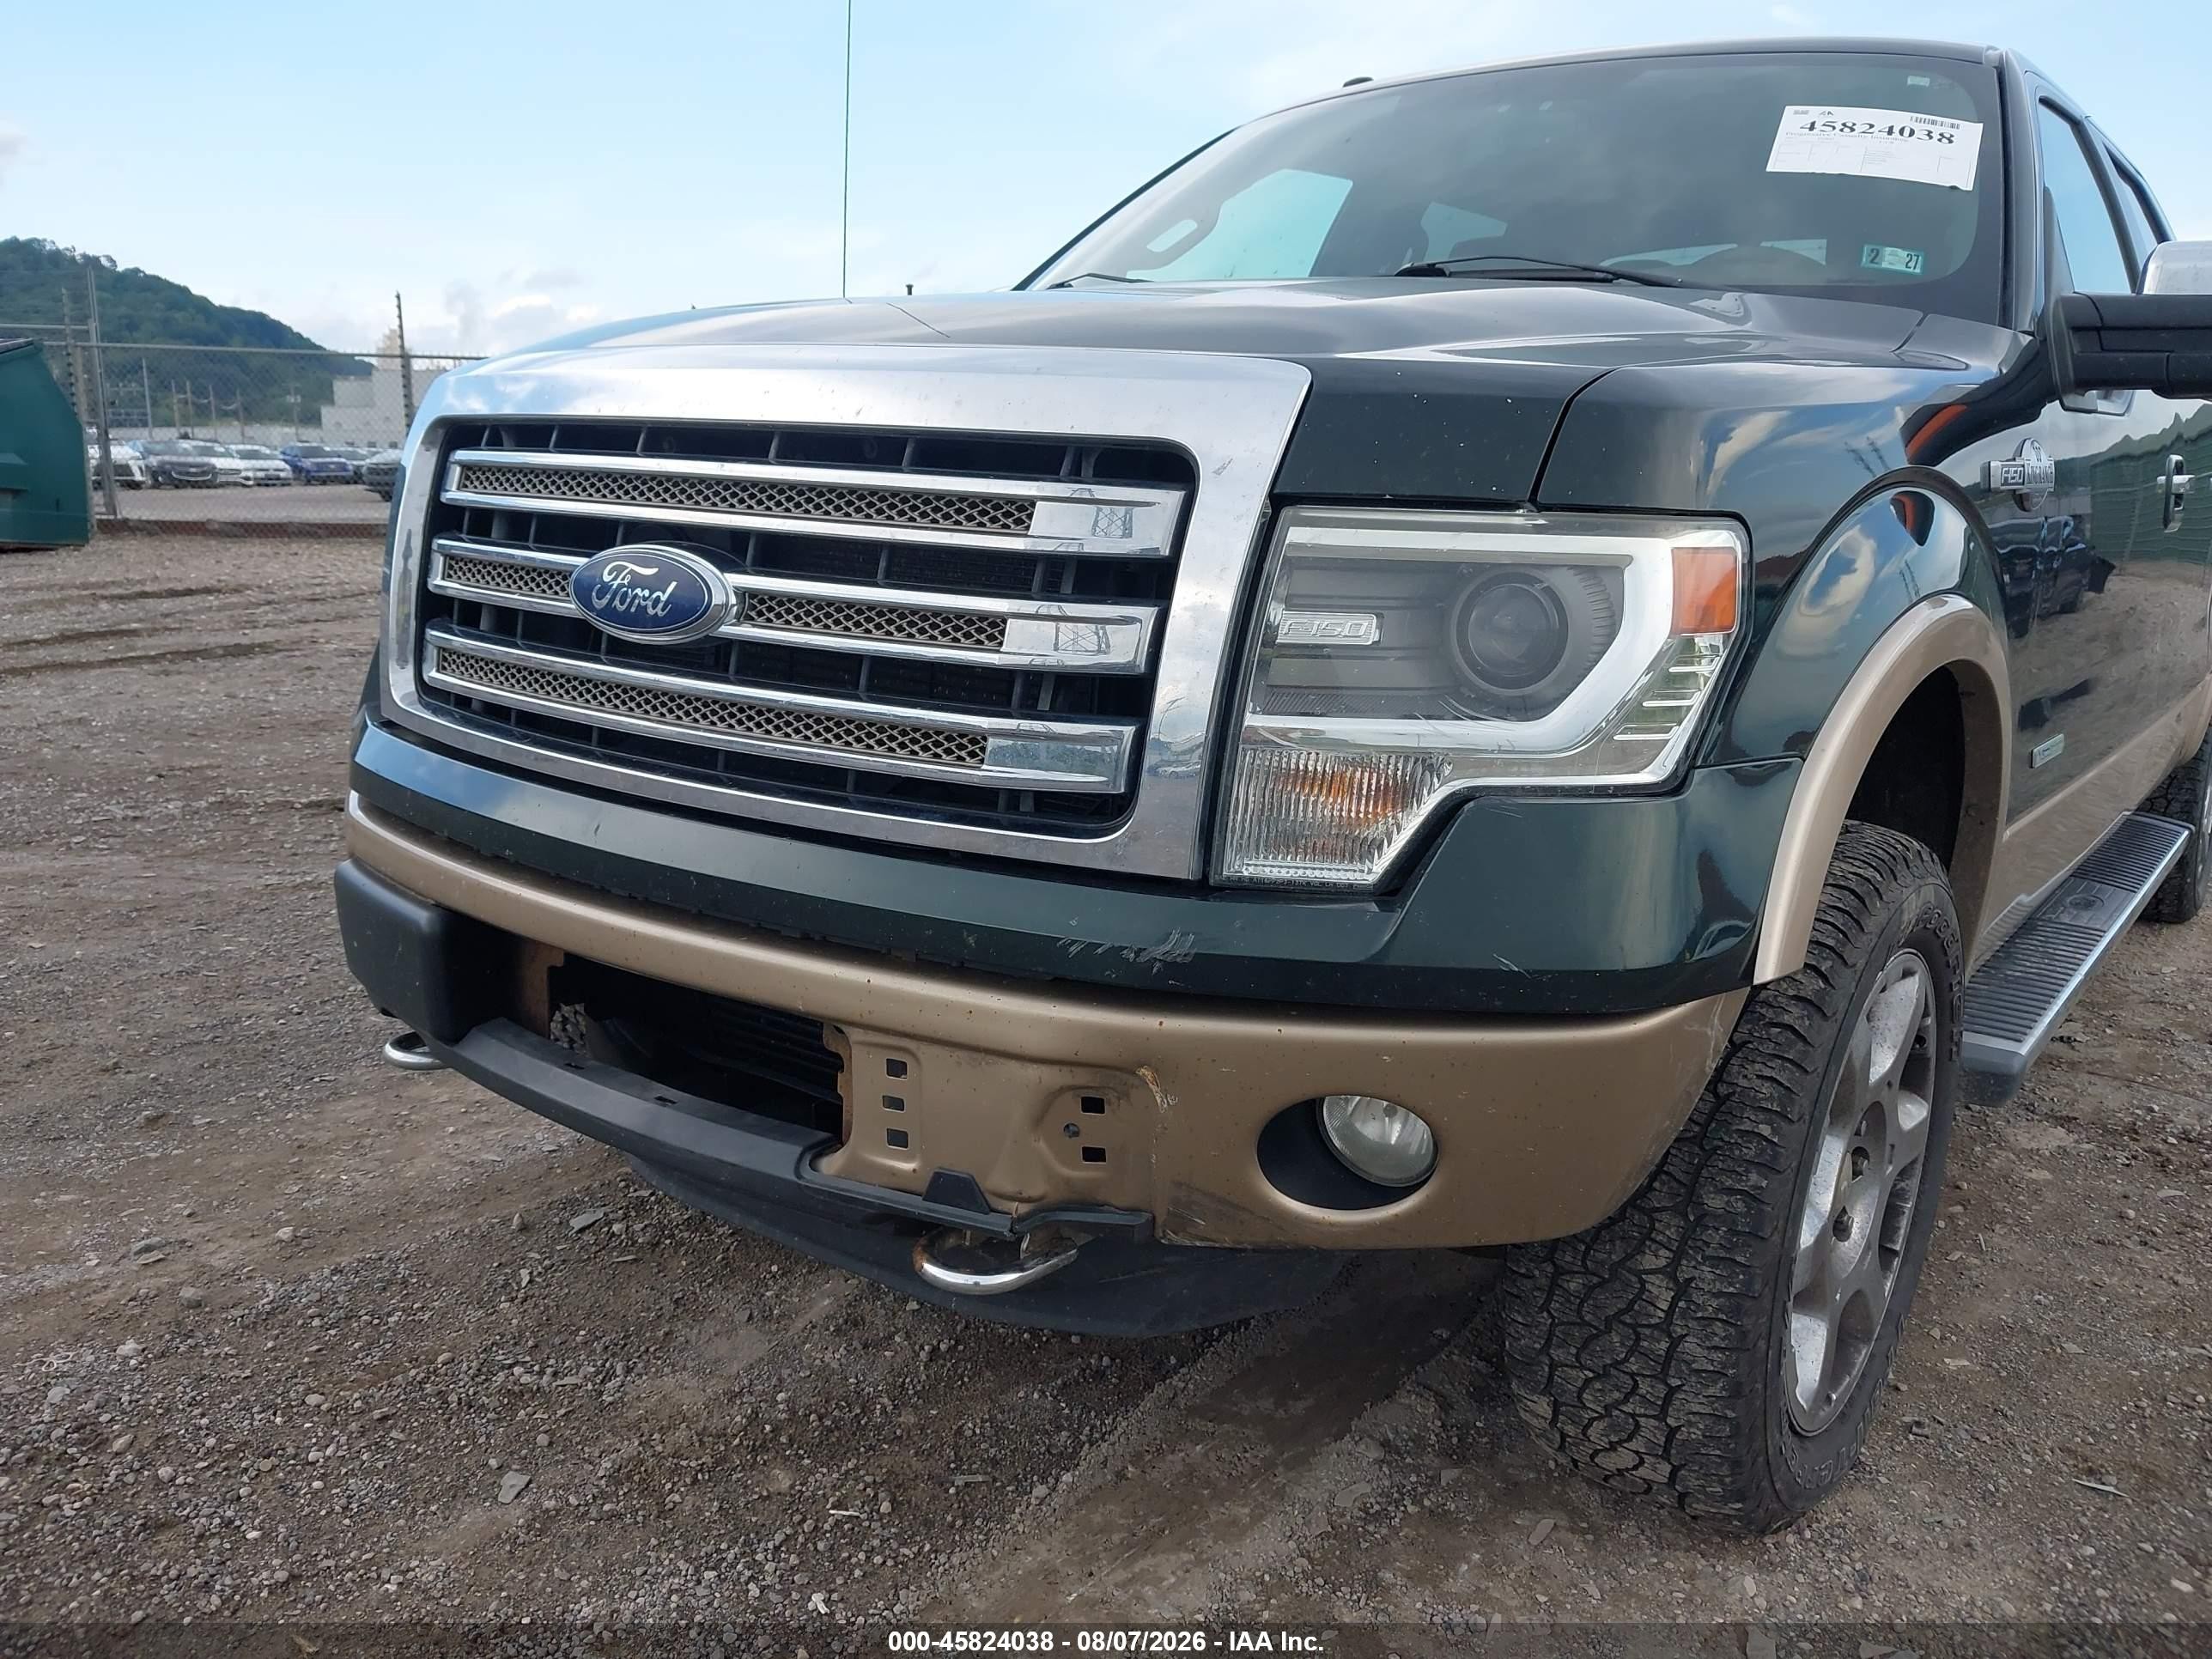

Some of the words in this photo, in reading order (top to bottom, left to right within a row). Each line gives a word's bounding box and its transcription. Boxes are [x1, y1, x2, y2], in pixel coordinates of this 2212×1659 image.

[1799, 120, 1955, 144] 45824038
[1869, 247, 1880, 265] 2
[1905, 252, 1920, 271] 27
[591, 561, 678, 617] Ford
[1282, 620, 1369, 638] F-150
